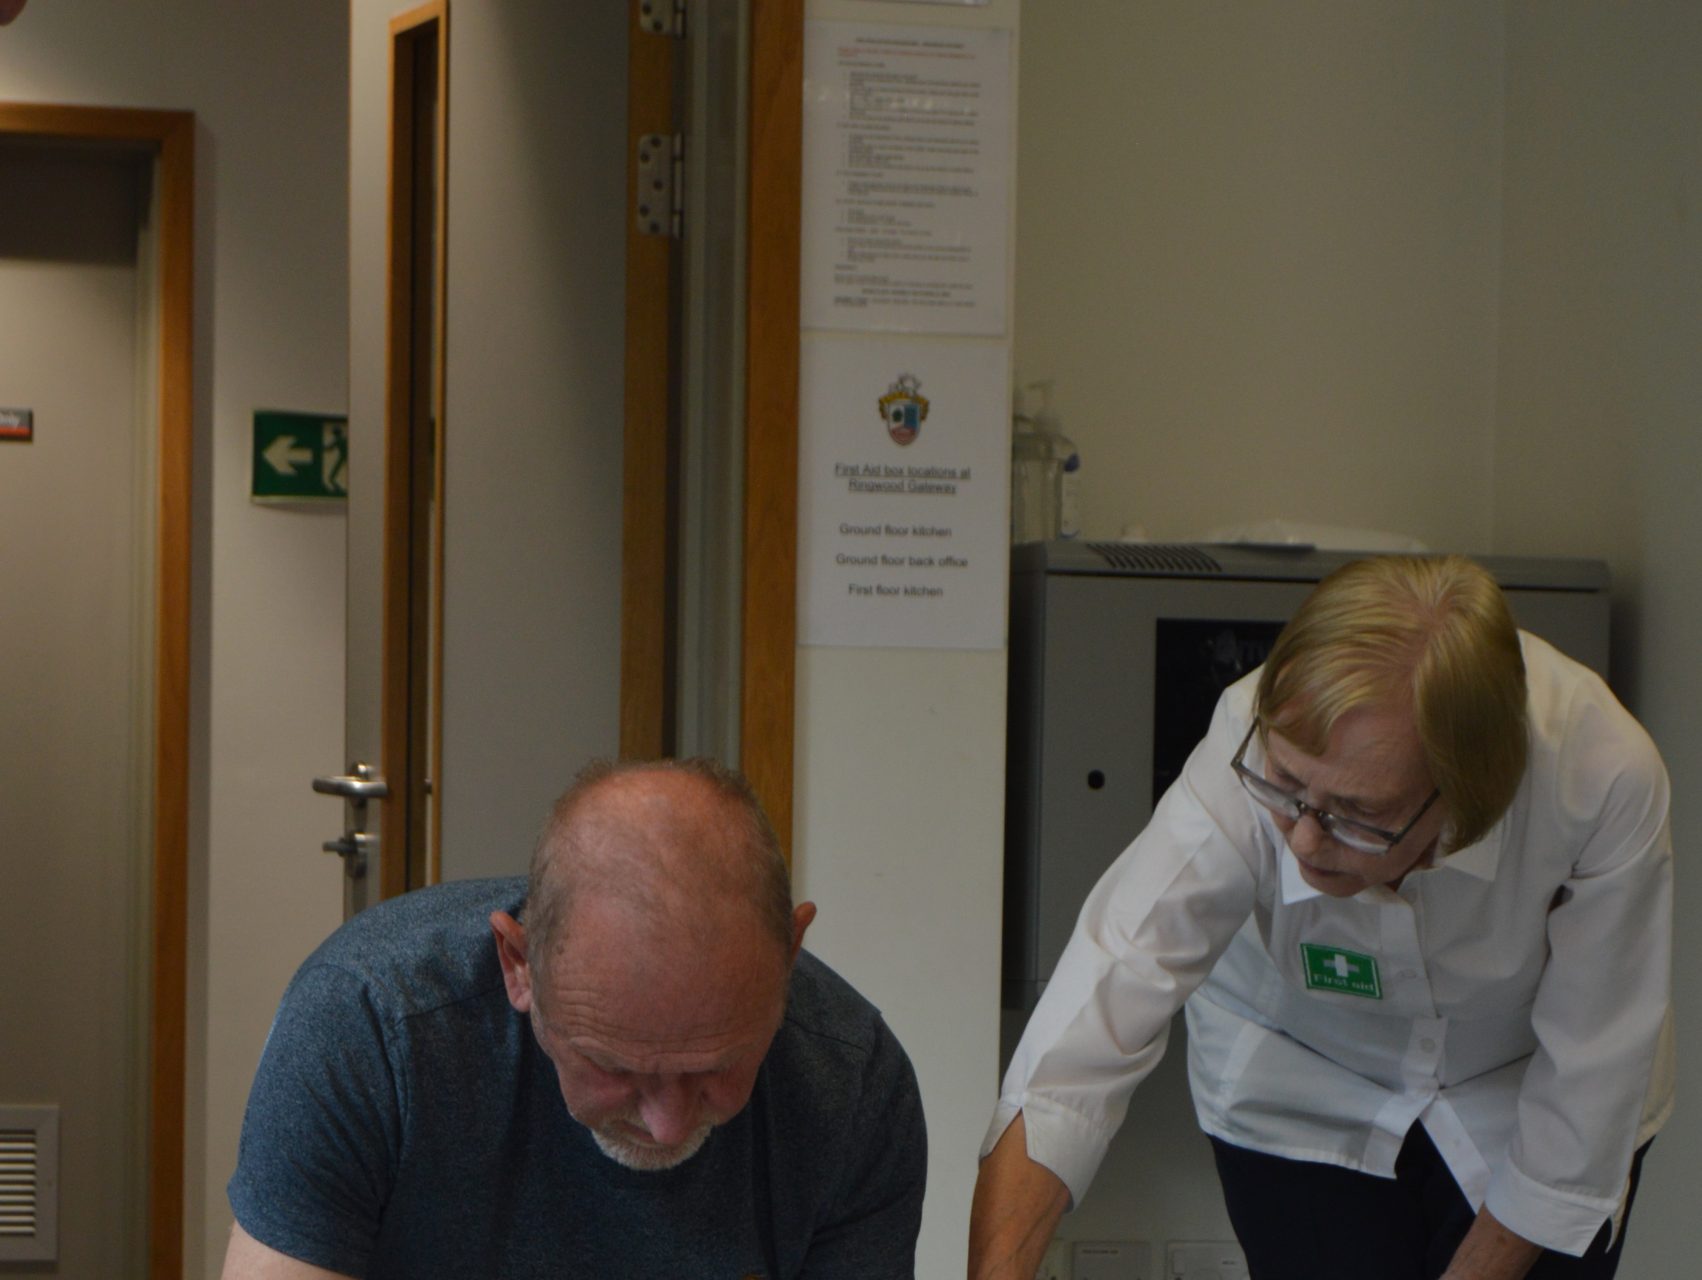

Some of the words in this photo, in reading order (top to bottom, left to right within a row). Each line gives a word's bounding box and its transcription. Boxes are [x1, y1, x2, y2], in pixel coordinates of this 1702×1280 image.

[835, 462, 859, 475] First
[862, 464, 881, 476] Aid
[884, 465, 904, 476] box
[907, 465, 957, 478] locations
[960, 467, 971, 479] at
[848, 479, 904, 493] Ringwood
[907, 480, 957, 495] Gateway
[839, 523, 882, 536] Ground
[884, 524, 909, 537] floor
[912, 525, 952, 538] kitchen
[836, 553, 878, 566] Ground
[881, 554, 905, 566] floor
[908, 555, 935, 567] back
[938, 555, 968, 568] office
[848, 583, 873, 595] First
[876, 584, 900, 596] floor
[903, 584, 943, 597] kitchen
